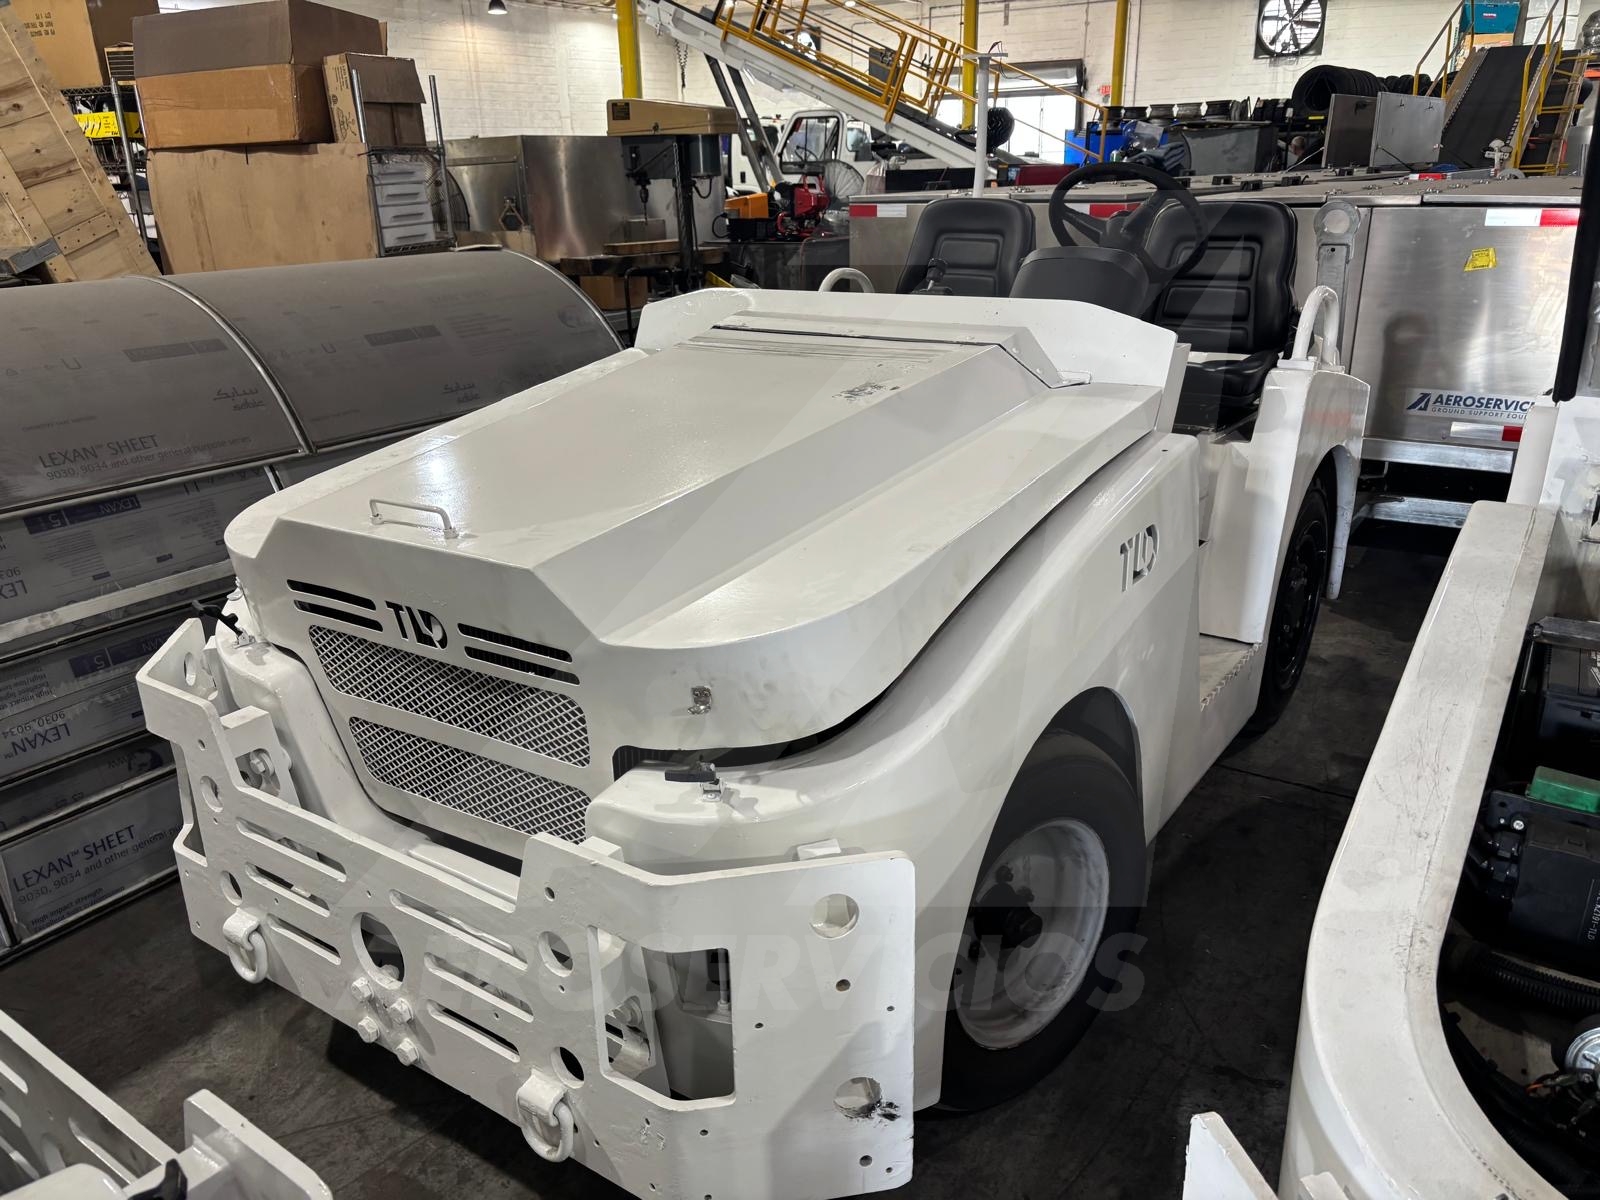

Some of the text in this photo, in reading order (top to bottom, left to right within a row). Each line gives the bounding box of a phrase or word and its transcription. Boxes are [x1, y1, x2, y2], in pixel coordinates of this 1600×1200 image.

[1431, 407, 1466, 415] GROUND
[106, 433, 160, 457] SHEET
[46, 466, 80, 481] 9030,
[81, 461, 109, 476] 9034
[110, 457, 129, 470] and
[130, 452, 155, 465] other
[48, 495, 139, 527] LEXAN 5
[1119, 523, 1160, 593] TLD
[385, 600, 448, 650] TLD
[93, 653, 105, 669] 5
[1, 722, 32, 740] 9034
[82, 824, 136, 861] SHEET
[17, 886, 52, 906] 9030,
[53, 869, 81, 890] 9034
[84, 857, 104, 875] and
[104, 847, 130, 864] other
